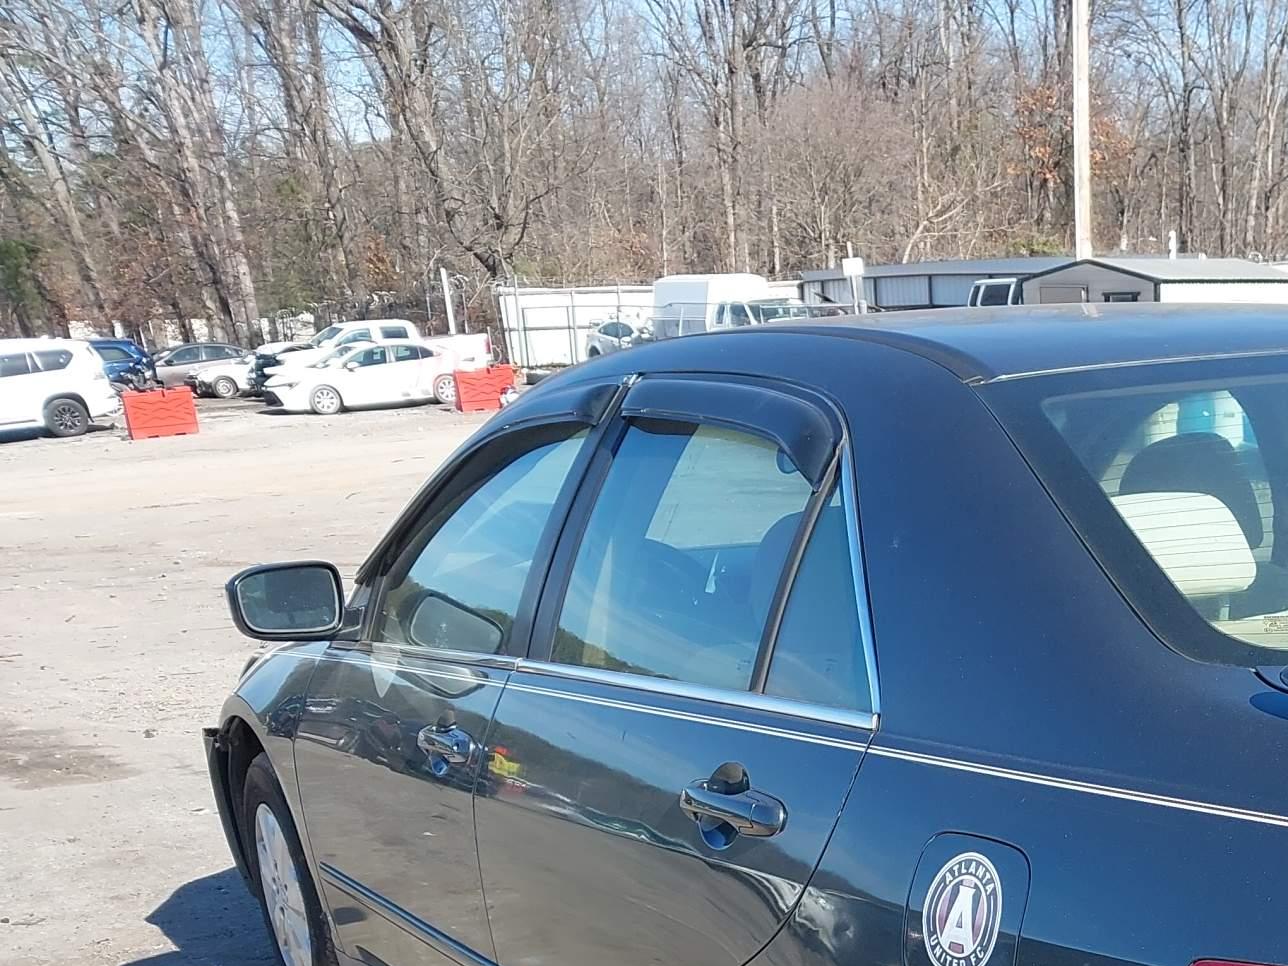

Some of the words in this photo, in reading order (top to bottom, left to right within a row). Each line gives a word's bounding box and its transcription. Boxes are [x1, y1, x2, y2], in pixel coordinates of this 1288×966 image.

[944, 861, 994, 896] ATLANTA
[940, 884, 976, 956] A
[970, 946, 984, 966] FC
